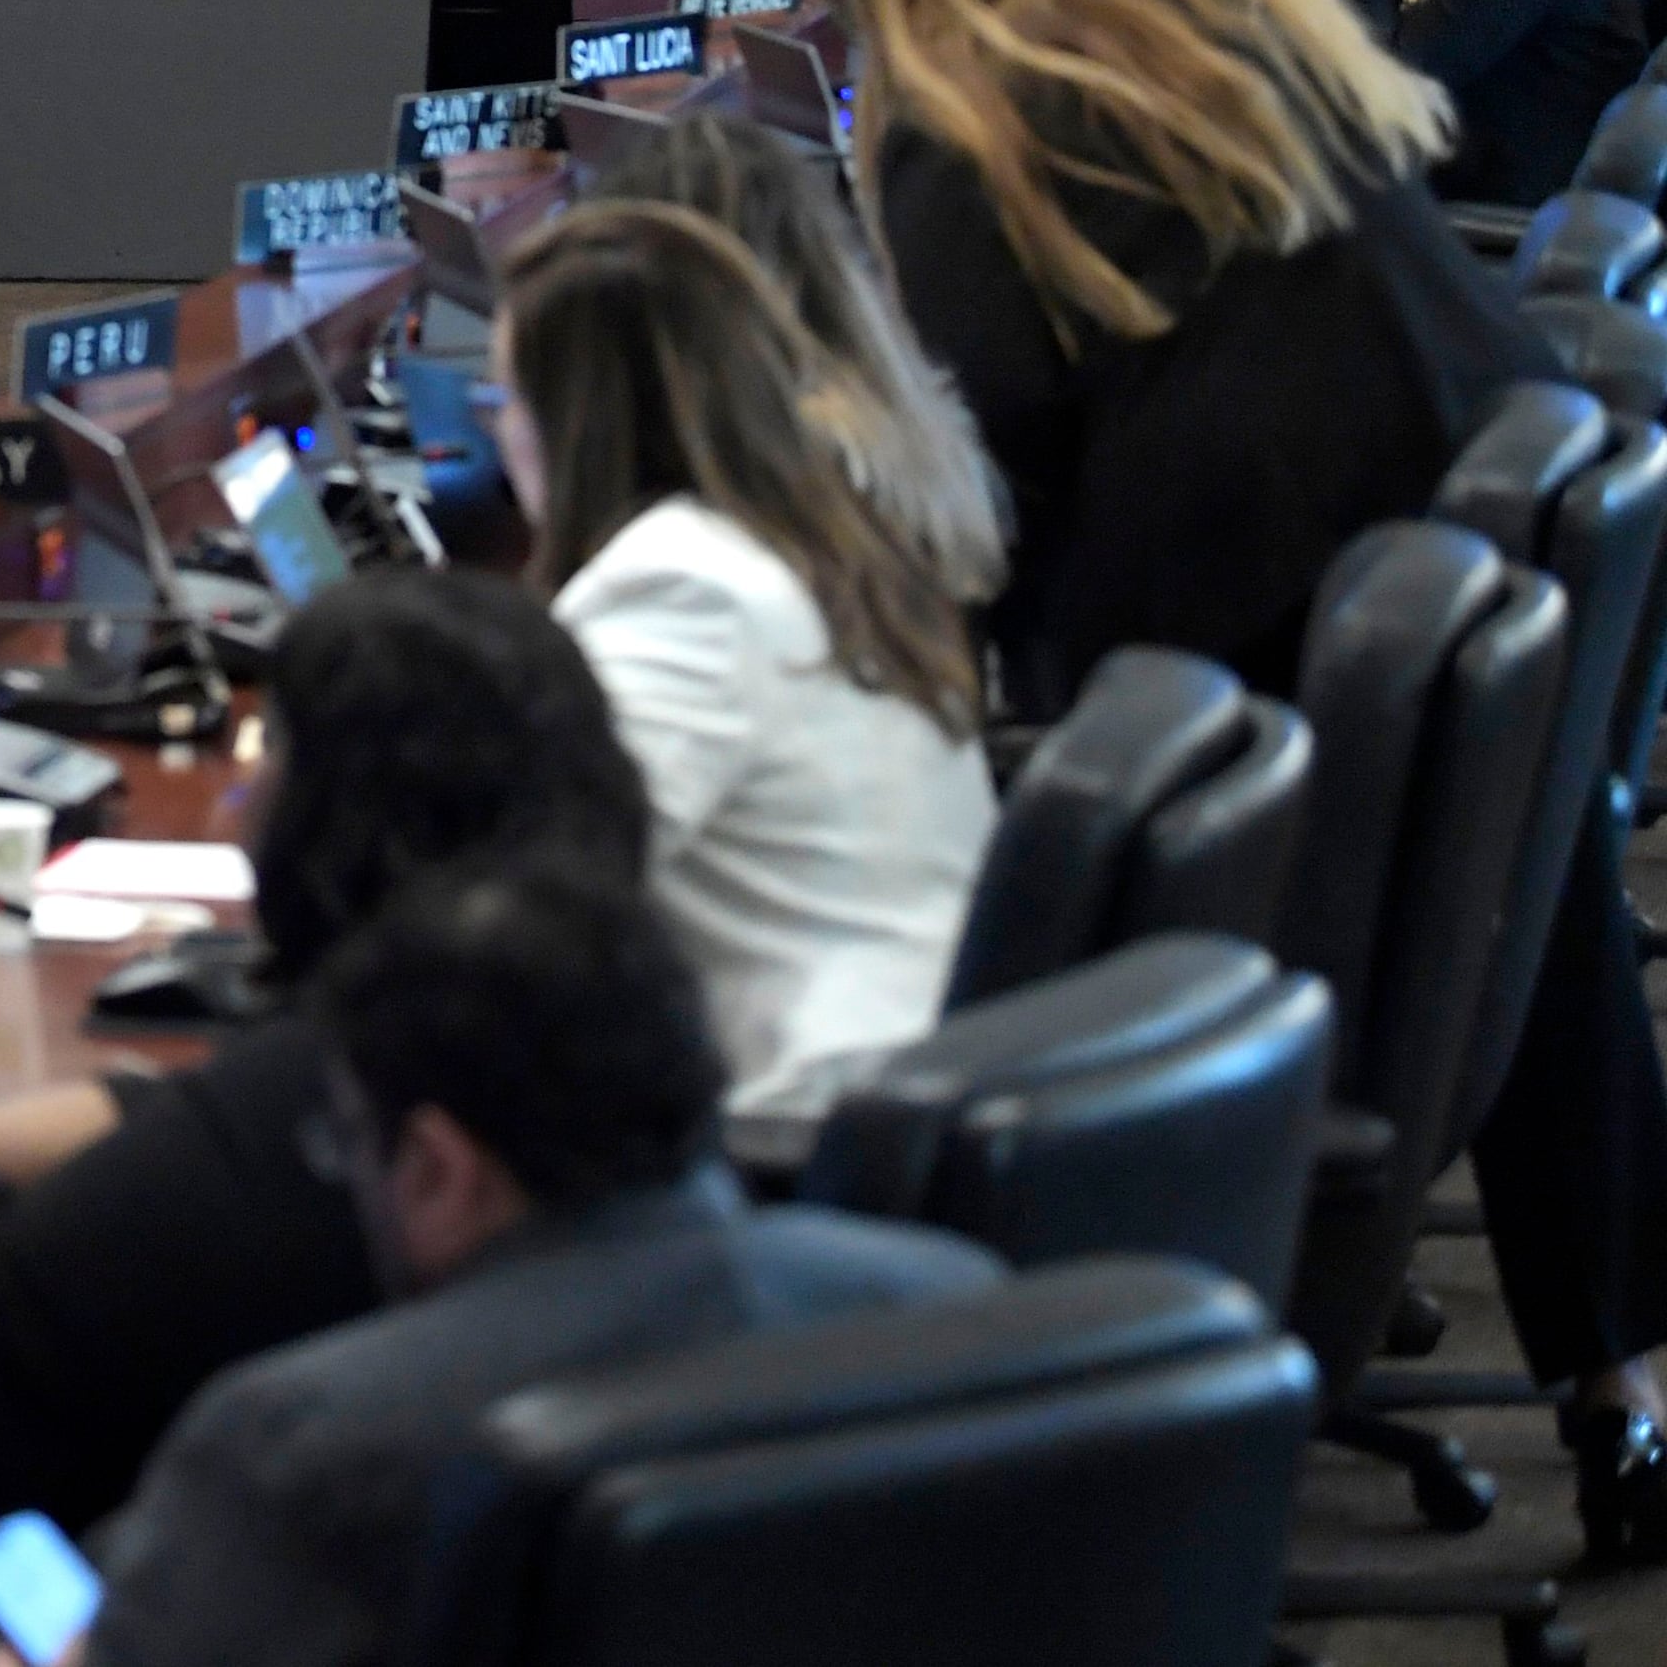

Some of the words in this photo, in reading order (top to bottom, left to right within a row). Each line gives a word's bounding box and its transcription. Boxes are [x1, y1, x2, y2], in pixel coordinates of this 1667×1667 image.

[570, 34, 632, 81] SAINT
[633, 25, 693, 71] LUCIA
[46, 319, 150, 381] PERU
